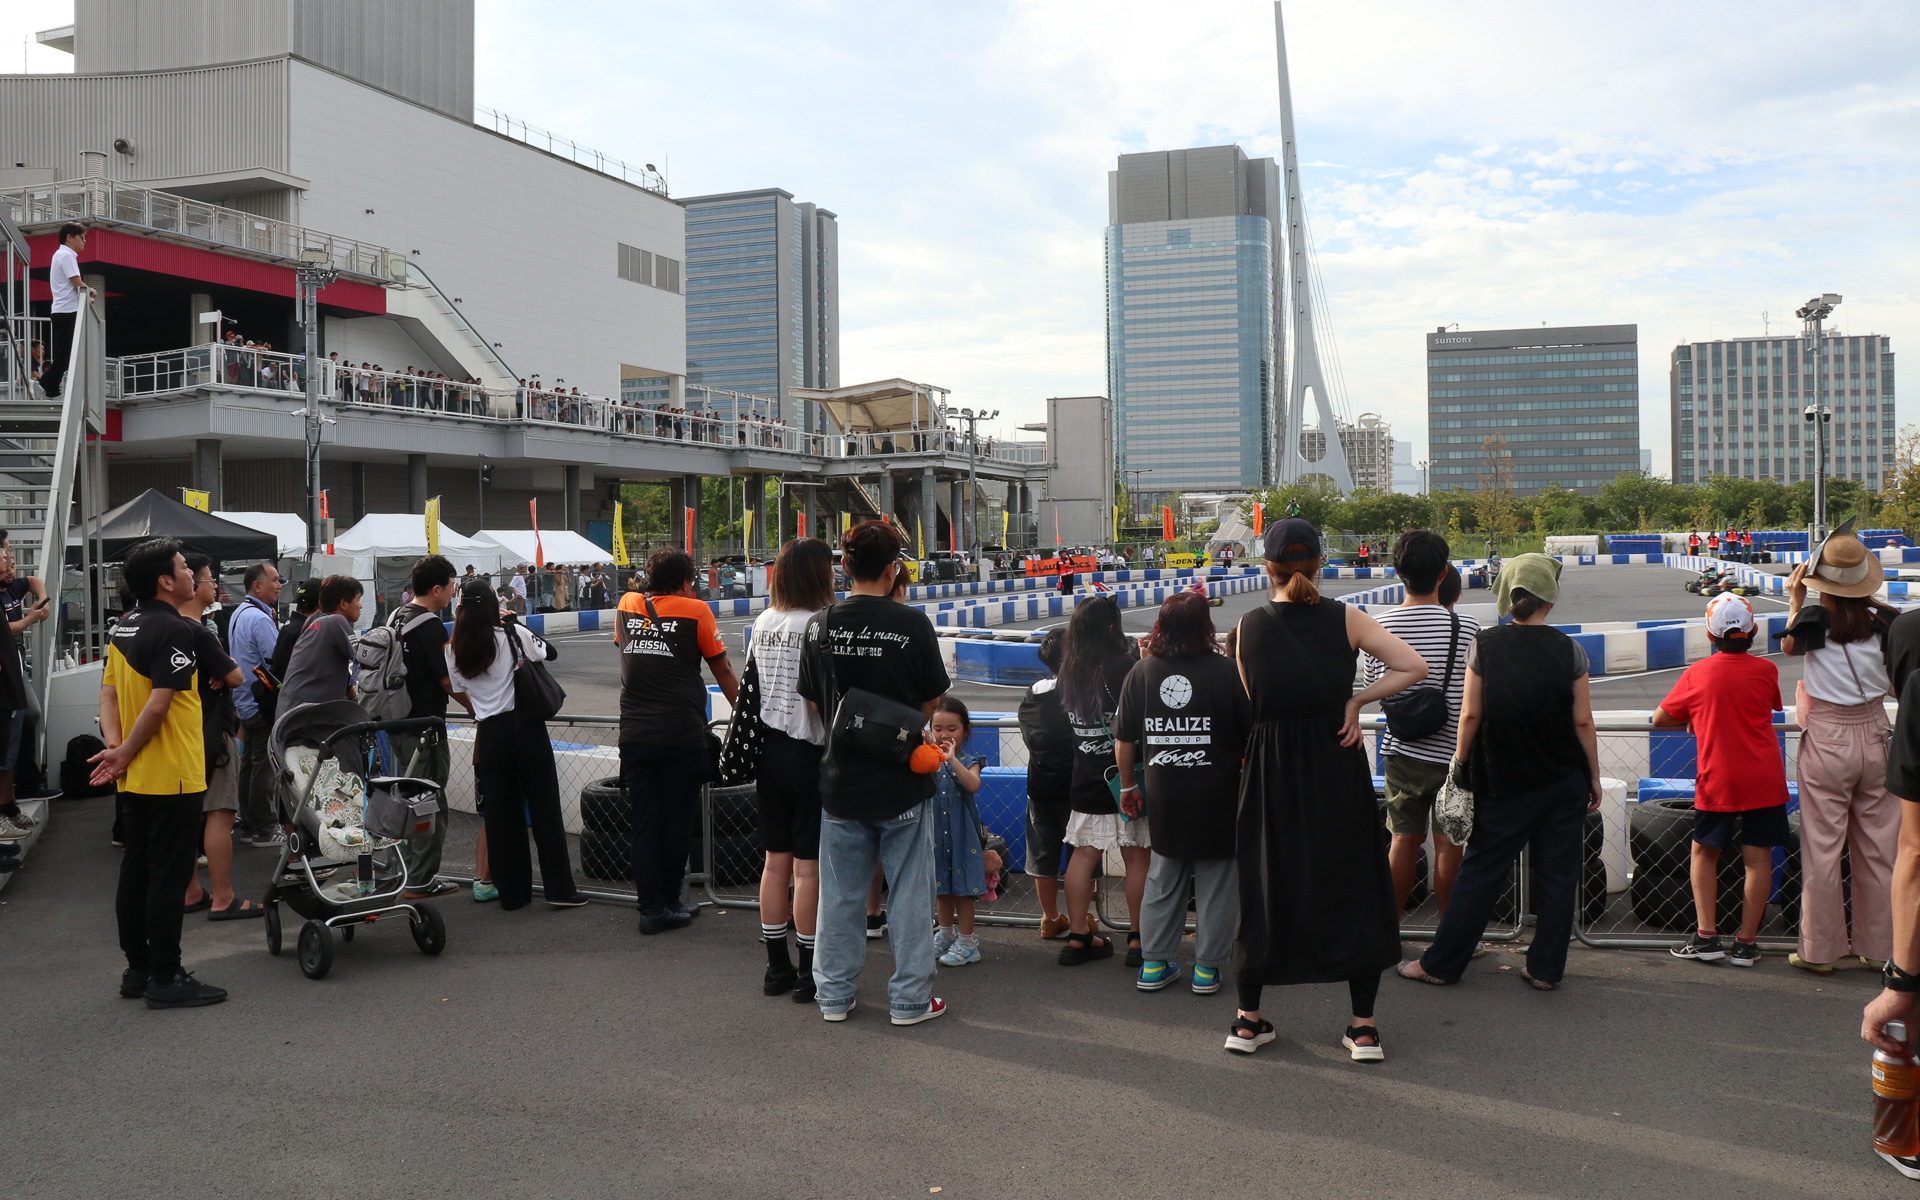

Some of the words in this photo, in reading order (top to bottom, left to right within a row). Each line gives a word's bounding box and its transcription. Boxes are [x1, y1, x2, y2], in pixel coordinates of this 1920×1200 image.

[1434, 336, 1473, 345] SUNTORY
[630, 629, 664, 639] RACIN
[1144, 716, 1211, 732] REALIZE
[1154, 736, 1202, 744] GROUP
